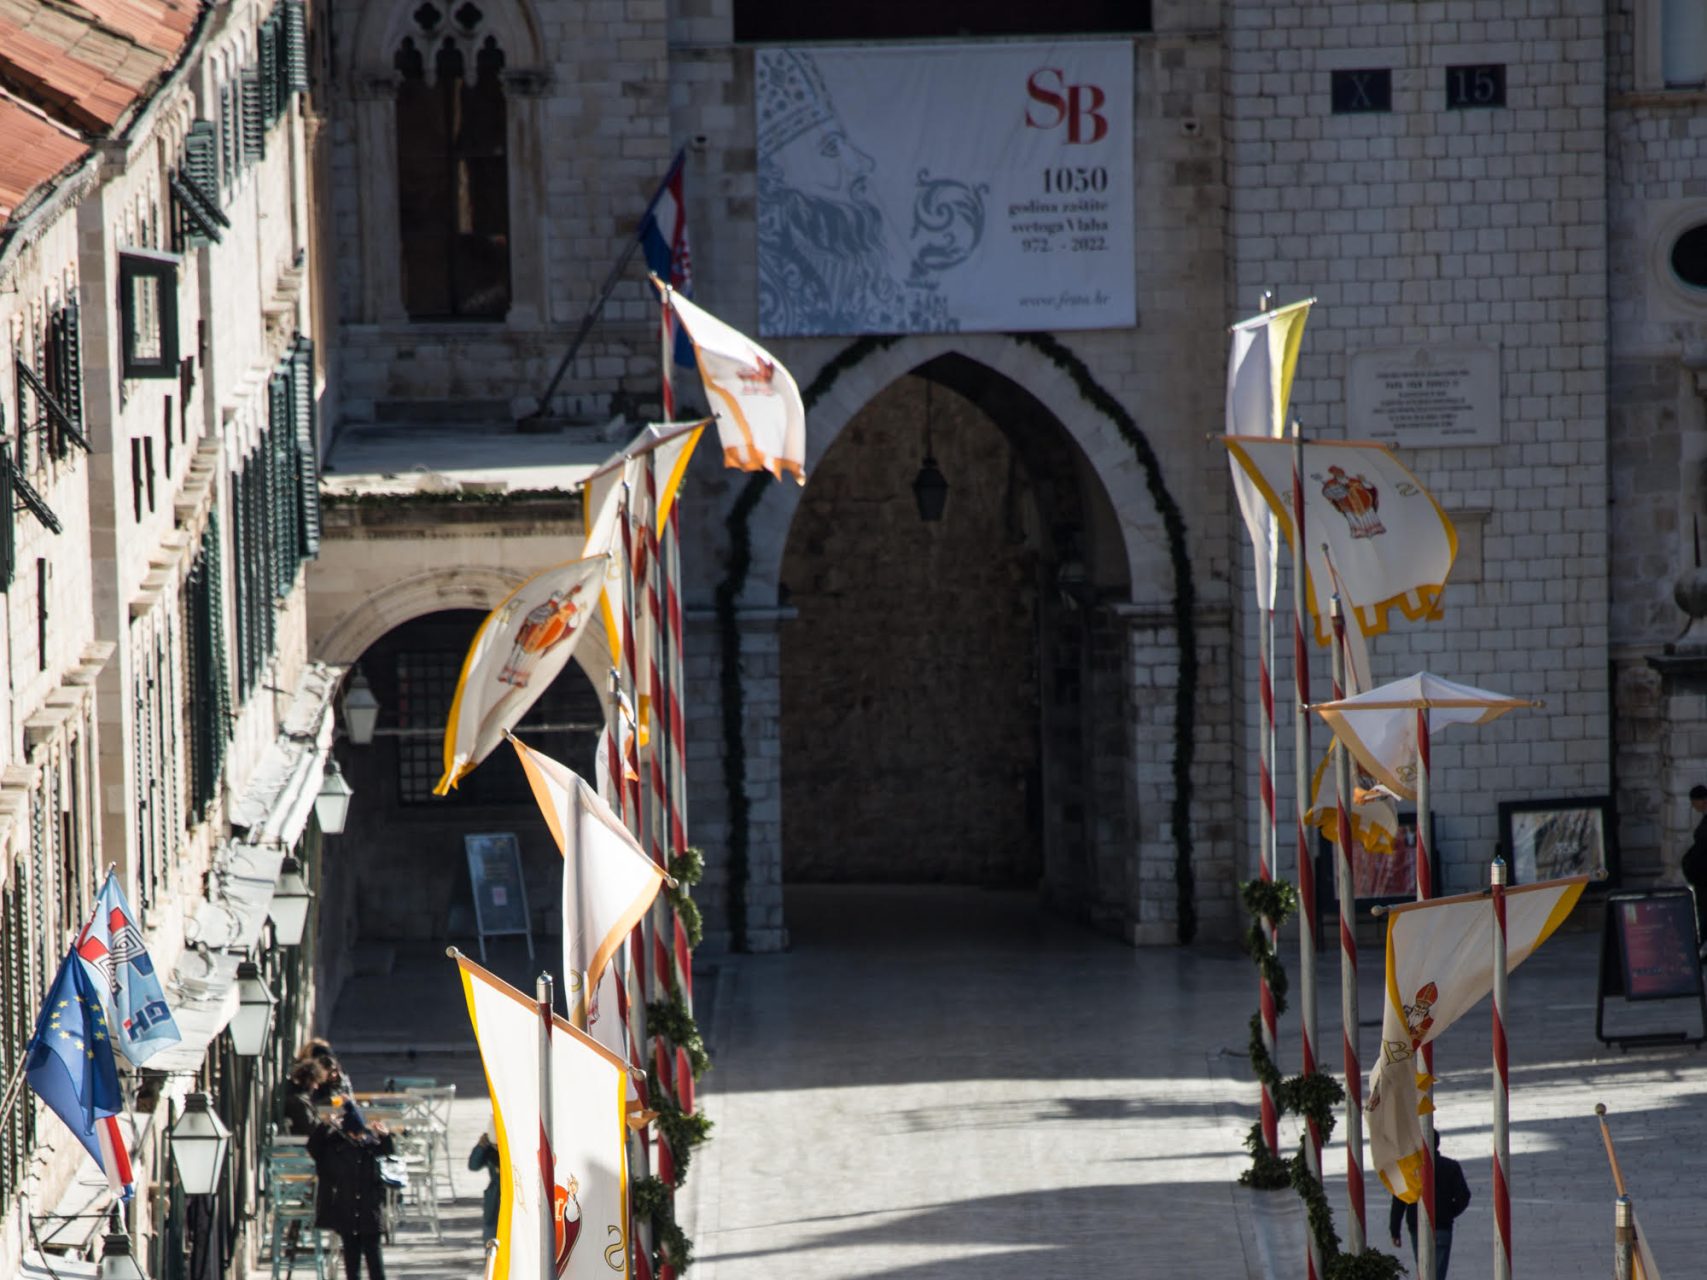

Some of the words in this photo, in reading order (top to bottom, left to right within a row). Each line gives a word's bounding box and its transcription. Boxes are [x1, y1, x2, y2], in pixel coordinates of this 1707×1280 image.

[1350, 73, 1373, 108] X
[1455, 69, 1495, 103] 15
[1025, 66, 1108, 145] SB
[1042, 166, 1108, 194] 1050
[1008, 199, 1058, 217] godina
[1062, 198, 1108, 213] zaštite
[1011, 221, 1064, 236] svetoga
[1066, 217, 1108, 232] Vlaha
